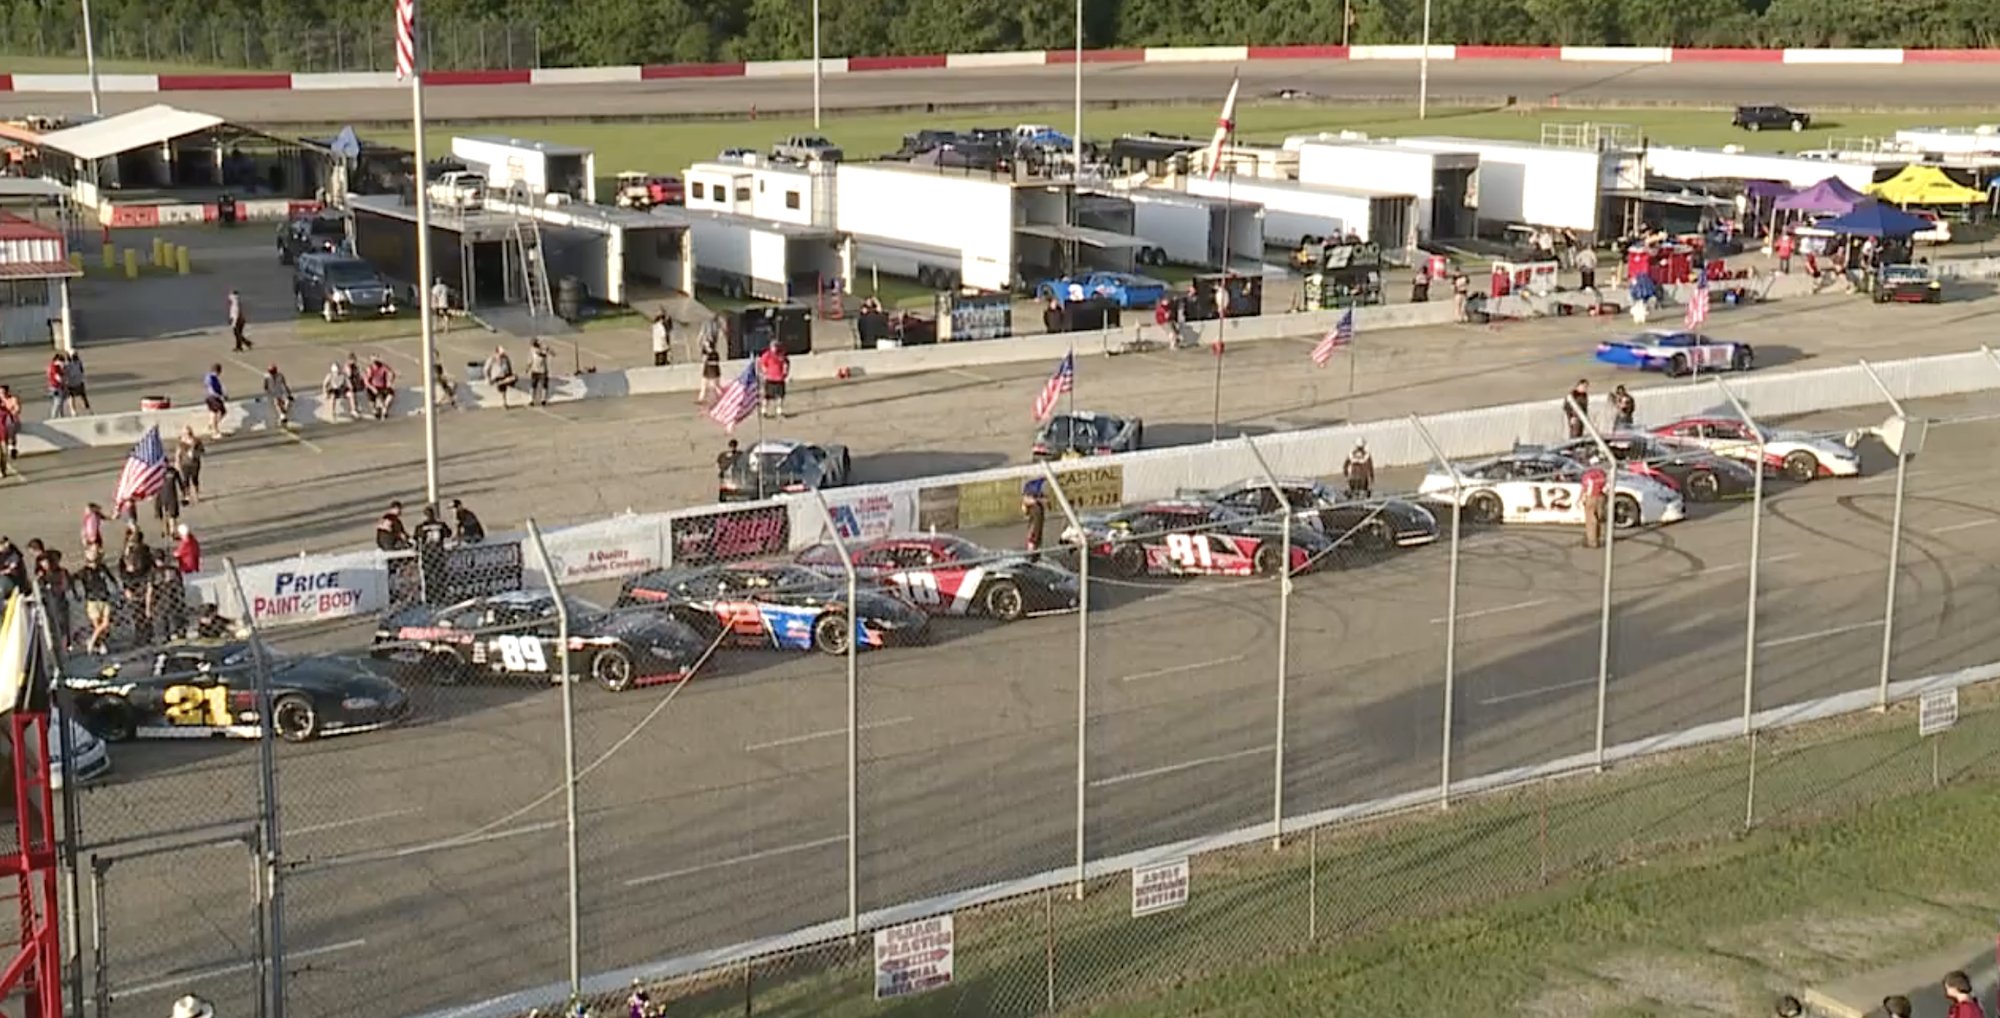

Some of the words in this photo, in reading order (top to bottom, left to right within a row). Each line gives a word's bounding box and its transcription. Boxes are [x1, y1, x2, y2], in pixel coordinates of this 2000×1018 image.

[1530, 485, 1572, 512] 12
[275, 572, 339, 595] PRICE
[254, 596, 301, 618] PAINT
[319, 589, 363, 613] BODY
[500, 634, 547, 672] 89
[164, 685, 233, 726] 21
